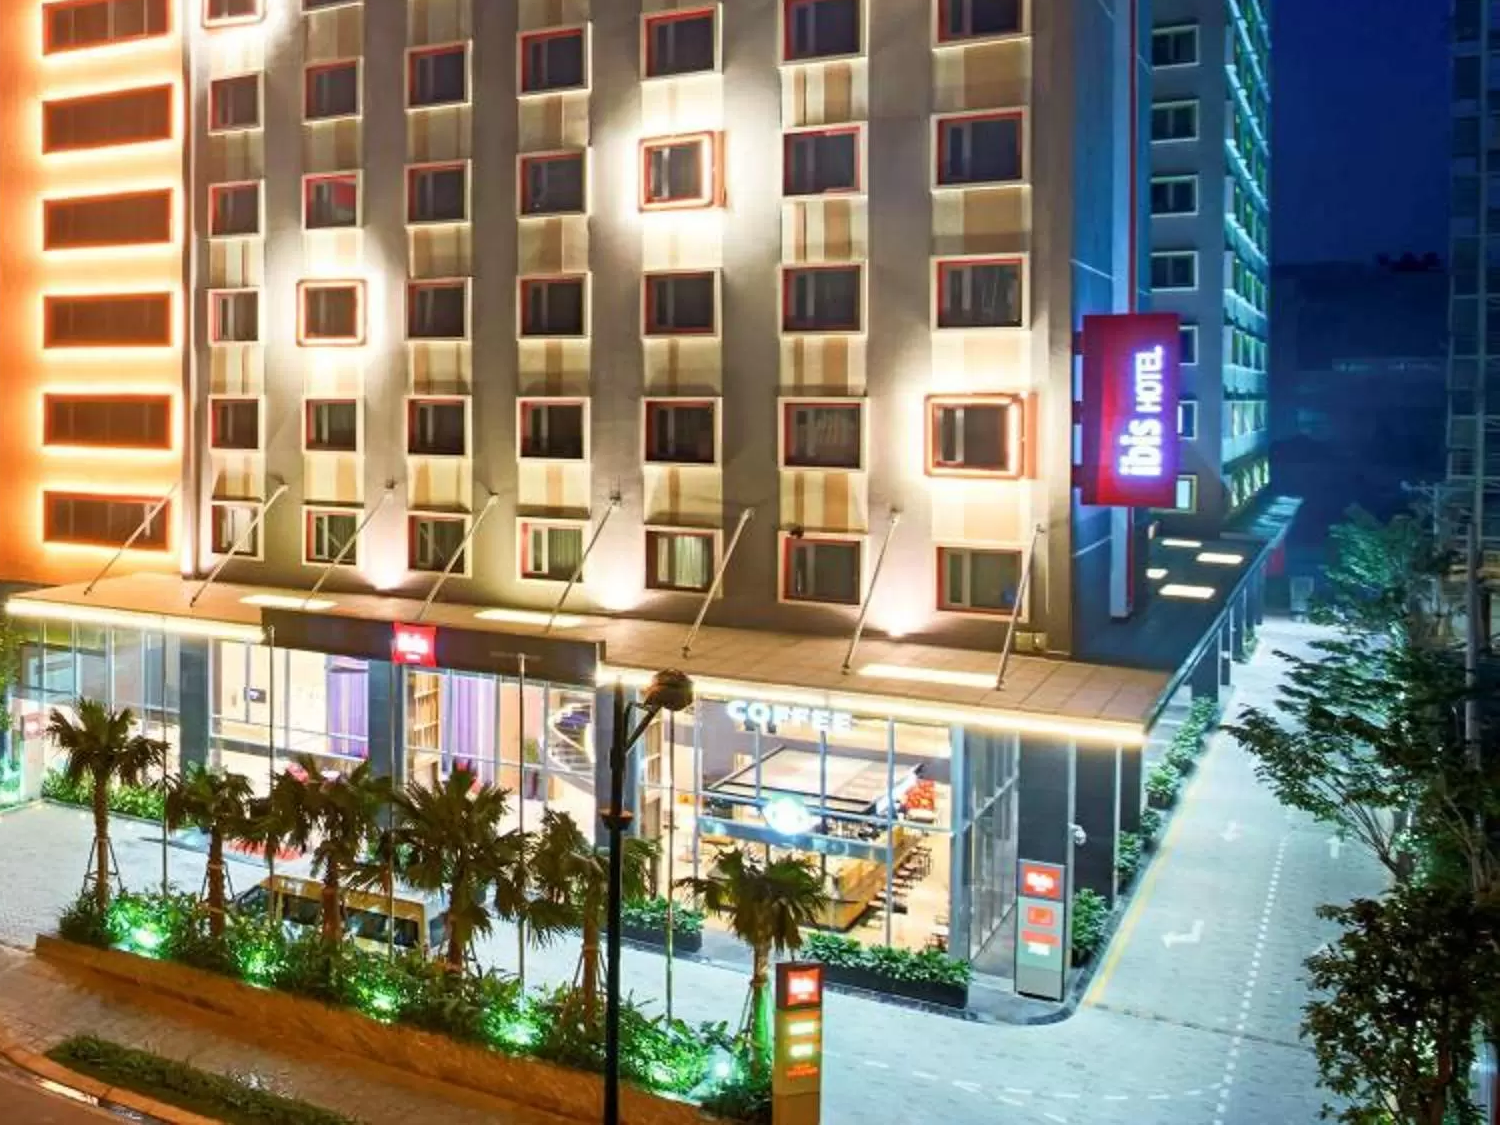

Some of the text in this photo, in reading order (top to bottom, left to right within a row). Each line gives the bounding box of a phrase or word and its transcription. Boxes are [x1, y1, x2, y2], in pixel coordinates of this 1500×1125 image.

[1118, 344, 1164, 476] ibis HOTEL
[726, 699, 853, 733] COFFEE
